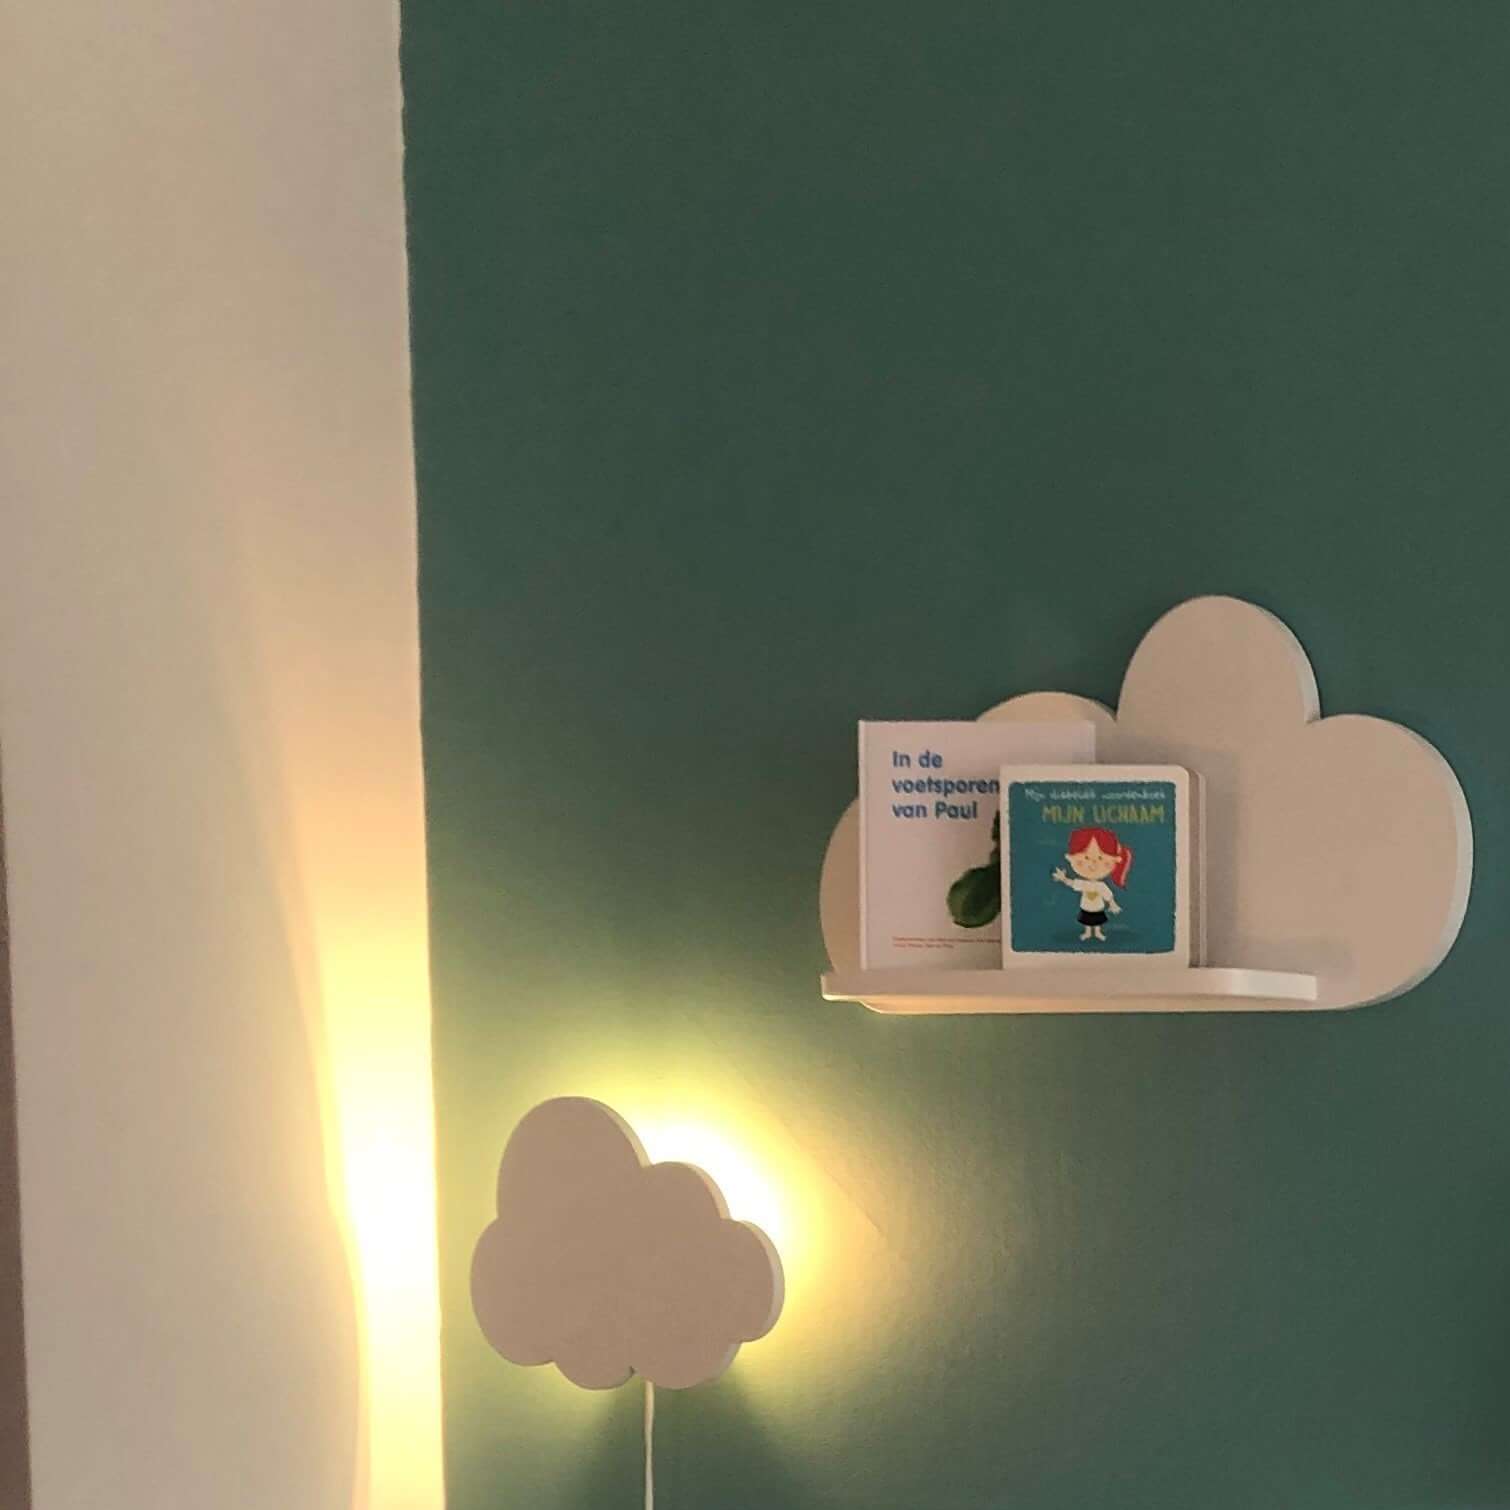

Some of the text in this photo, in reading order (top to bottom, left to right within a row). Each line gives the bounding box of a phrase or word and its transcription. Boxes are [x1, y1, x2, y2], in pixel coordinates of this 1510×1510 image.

[892, 749, 943, 769] In de
[892, 776, 1000, 798] voetsporen
[892, 801, 977, 819] van Paul
[1042, 804, 1084, 824] MIJN
